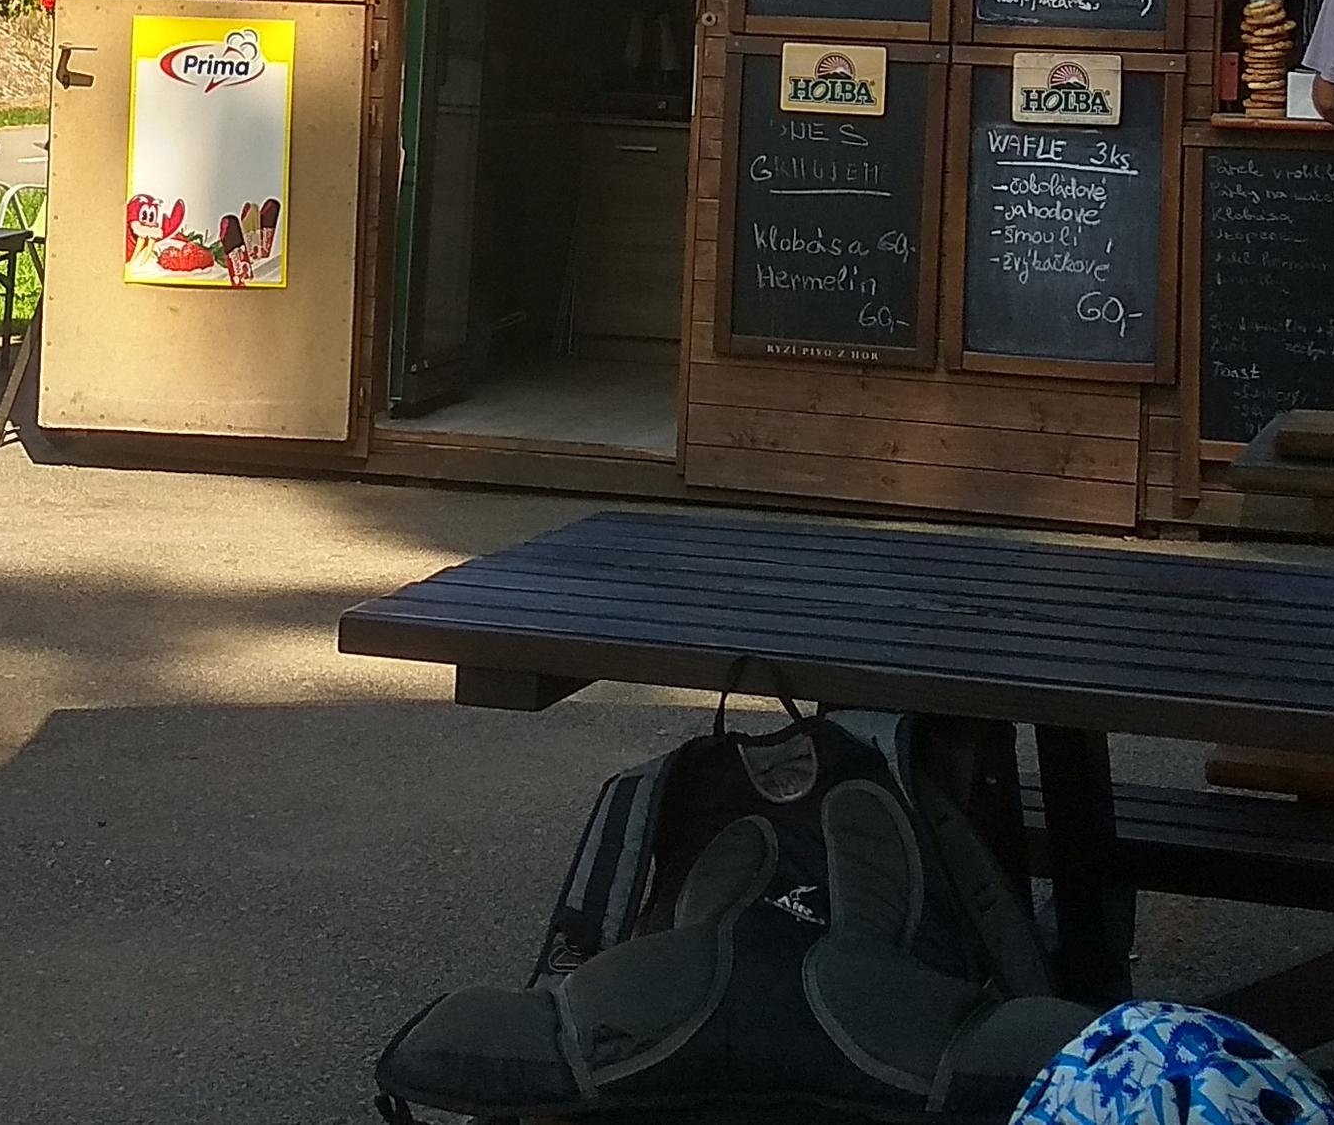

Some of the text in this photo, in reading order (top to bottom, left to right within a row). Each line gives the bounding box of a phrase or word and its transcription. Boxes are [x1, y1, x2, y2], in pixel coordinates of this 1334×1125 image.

[183, 55, 250, 77] Prima
[789, 77, 877, 106] HOLBA
[1021, 87, 1112, 115] HOLBA
[988, 129, 1067, 161] WAFLE
